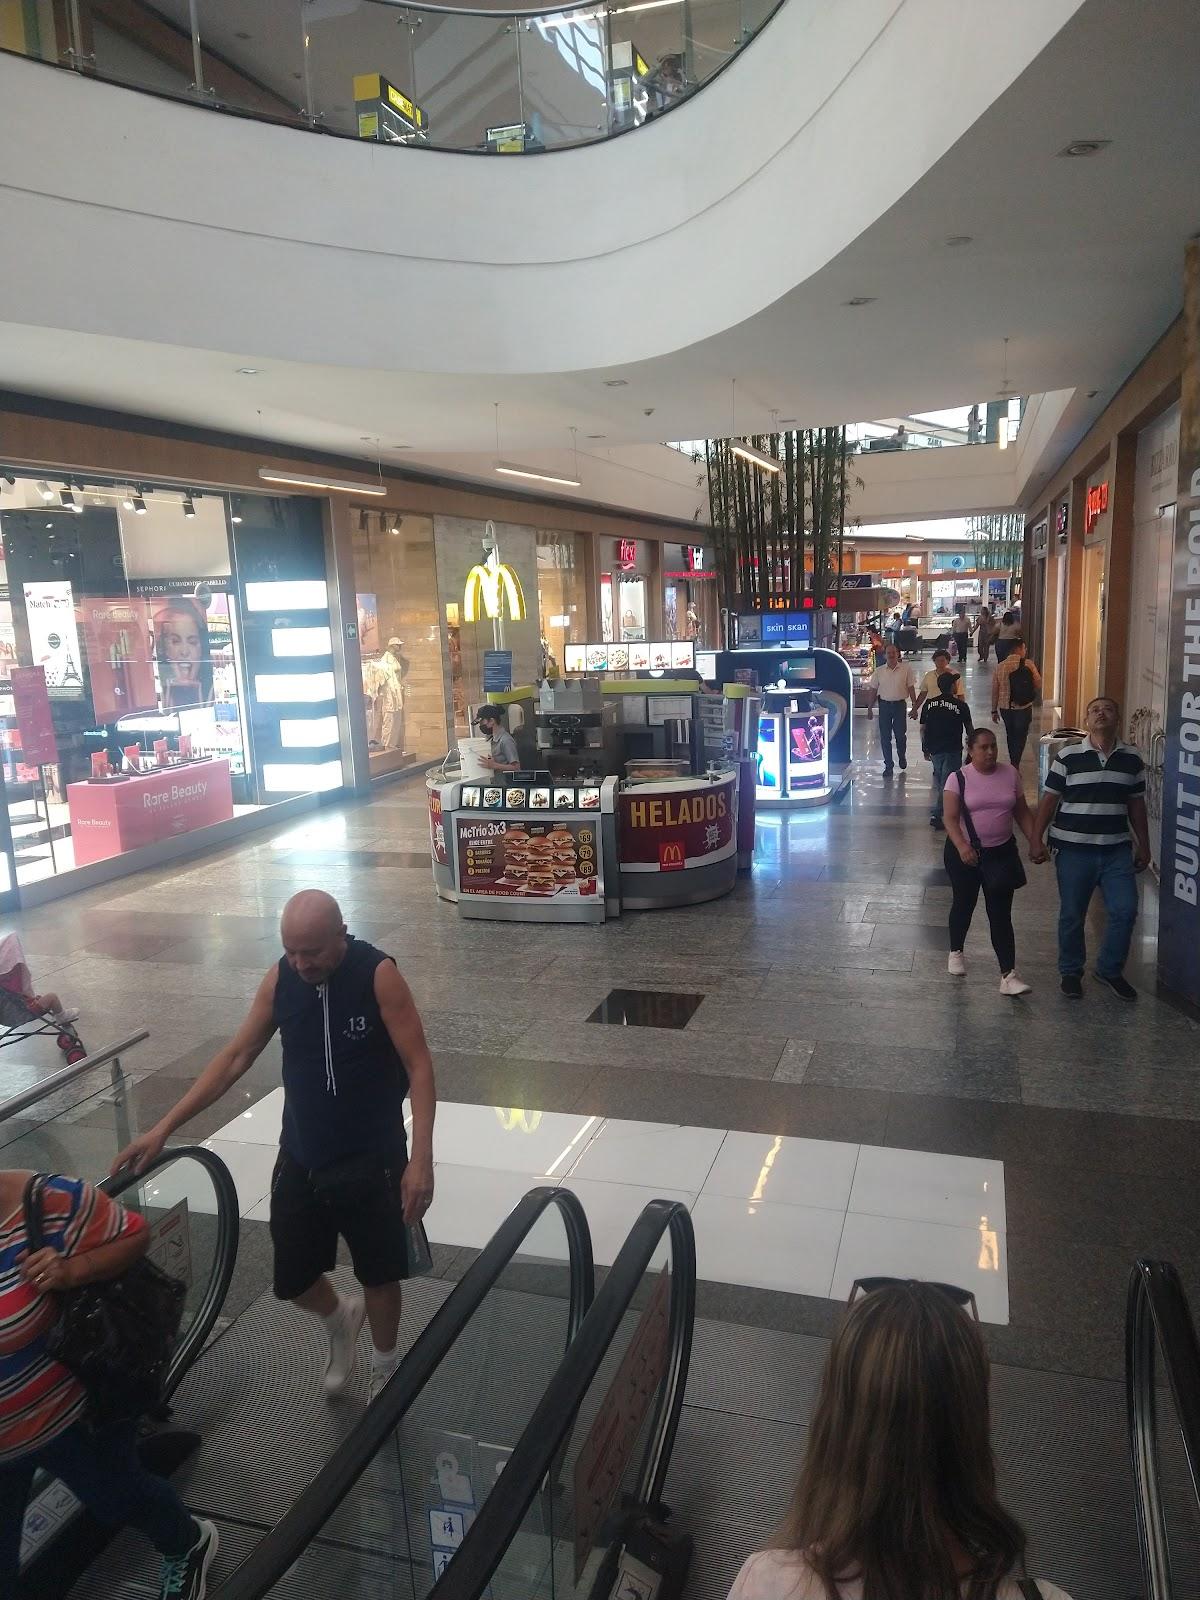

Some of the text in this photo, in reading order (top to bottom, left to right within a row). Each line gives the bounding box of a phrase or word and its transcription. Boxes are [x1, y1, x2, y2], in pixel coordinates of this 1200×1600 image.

[621, 539, 637, 561] flexi
[1184, 598, 1200, 683] THE
[1178, 691, 1200, 776] FOR
[143, 791, 169, 808] Rare
[171, 781, 208, 800] Beauty
[77, 818, 111, 827] Rare Beauty
[630, 792, 726, 828] HELADOS
[460, 825, 487, 839] McTrio
[487, 821, 507, 836] 3x3
[1174, 782, 1200, 906] BUILT
[349, 1016, 366, 1031] 13
